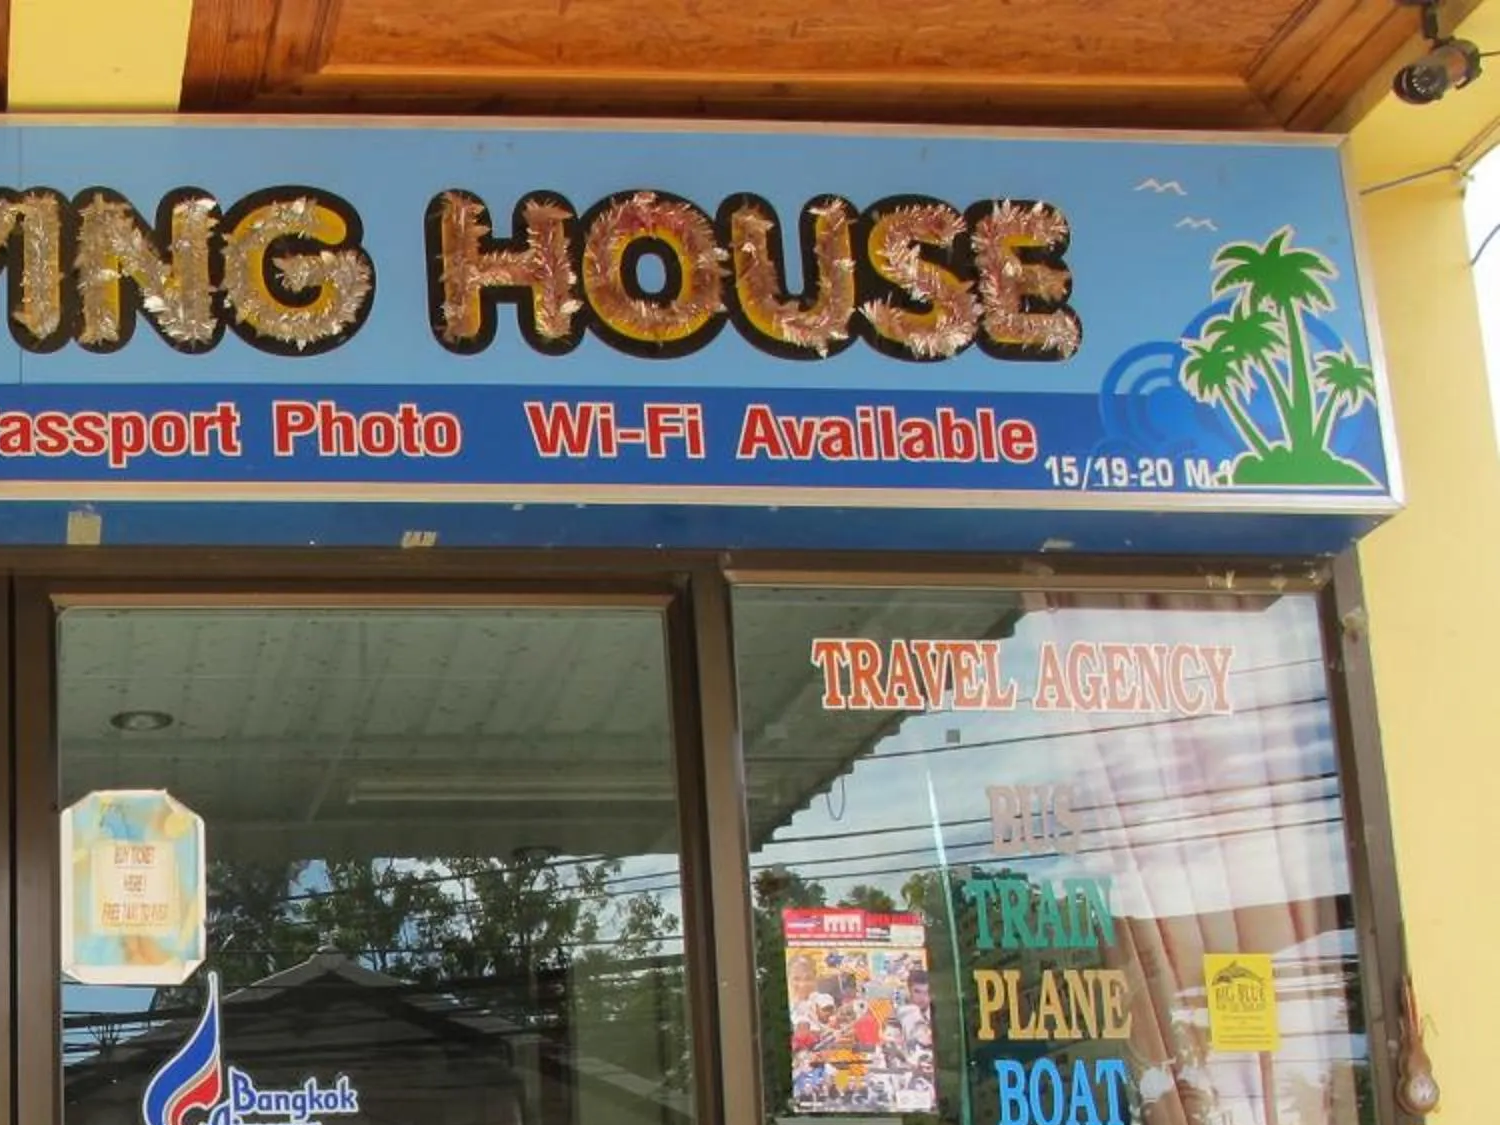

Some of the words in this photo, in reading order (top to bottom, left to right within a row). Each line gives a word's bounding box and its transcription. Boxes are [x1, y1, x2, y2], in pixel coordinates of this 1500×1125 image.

[424, 188, 1083, 363] HOUSE
[272, 400, 463, 459] Photo
[525, 402, 705, 460] Wi-Fi
[737, 406, 1038, 464] Available
[1044, 456, 1174, 490] 15/19-20
[812, 637, 1018, 711] TRAVEL
[1035, 640, 1235, 715] AGENCY
[986, 785, 1084, 855] BUS
[963, 876, 1117, 951] TRAIN
[973, 969, 1132, 1042] PLANE
[227, 1065, 359, 1120] Bangkok
